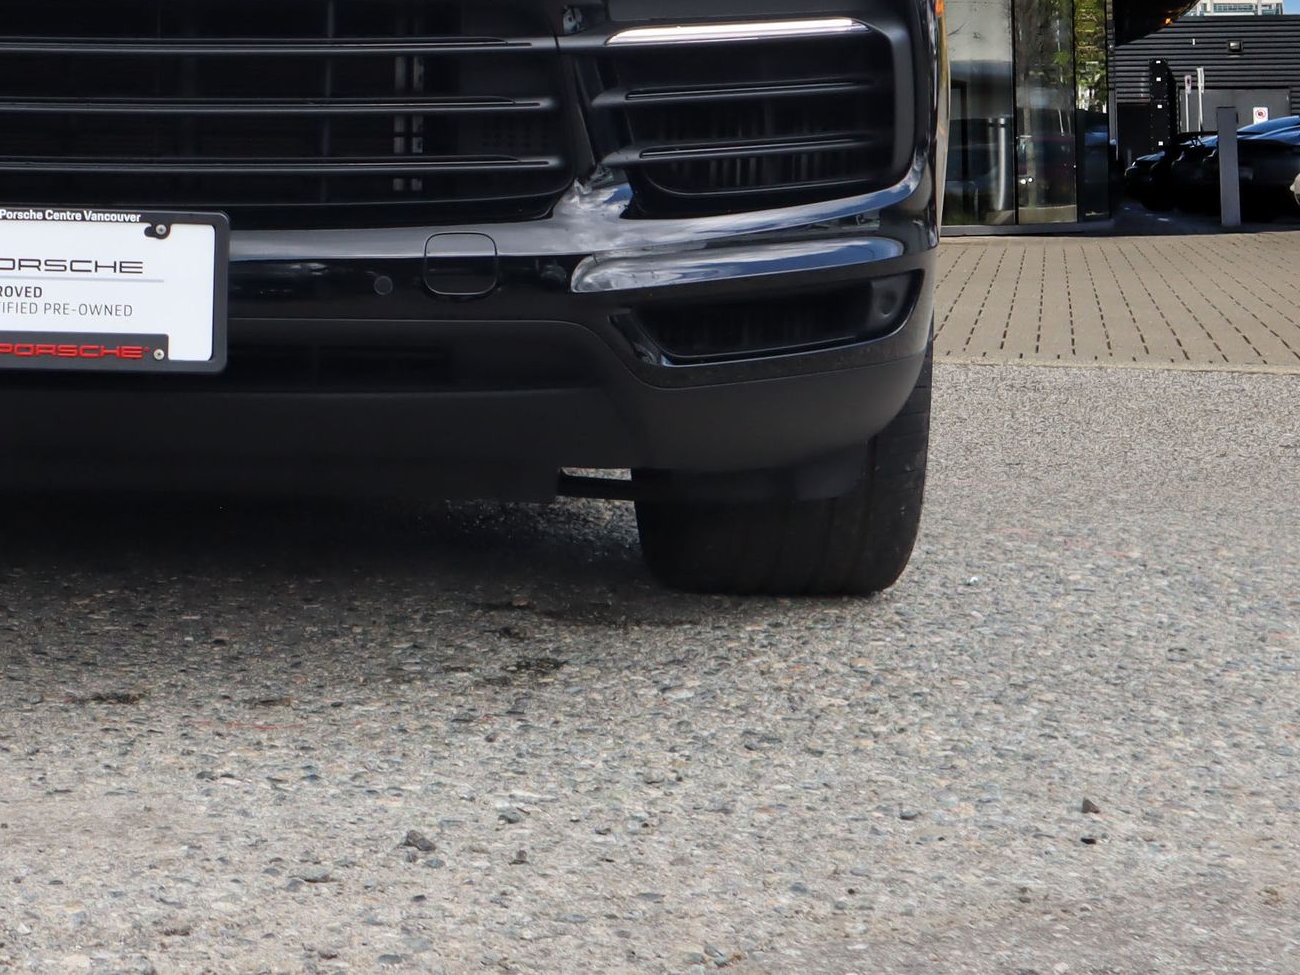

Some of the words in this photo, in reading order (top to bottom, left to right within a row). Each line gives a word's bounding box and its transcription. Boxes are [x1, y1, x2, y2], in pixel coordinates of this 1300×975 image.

[45, 209, 82, 221] Centre
[83, 210, 141, 223] Vancouver
[43, 303, 133, 317] PRE-OWNED
